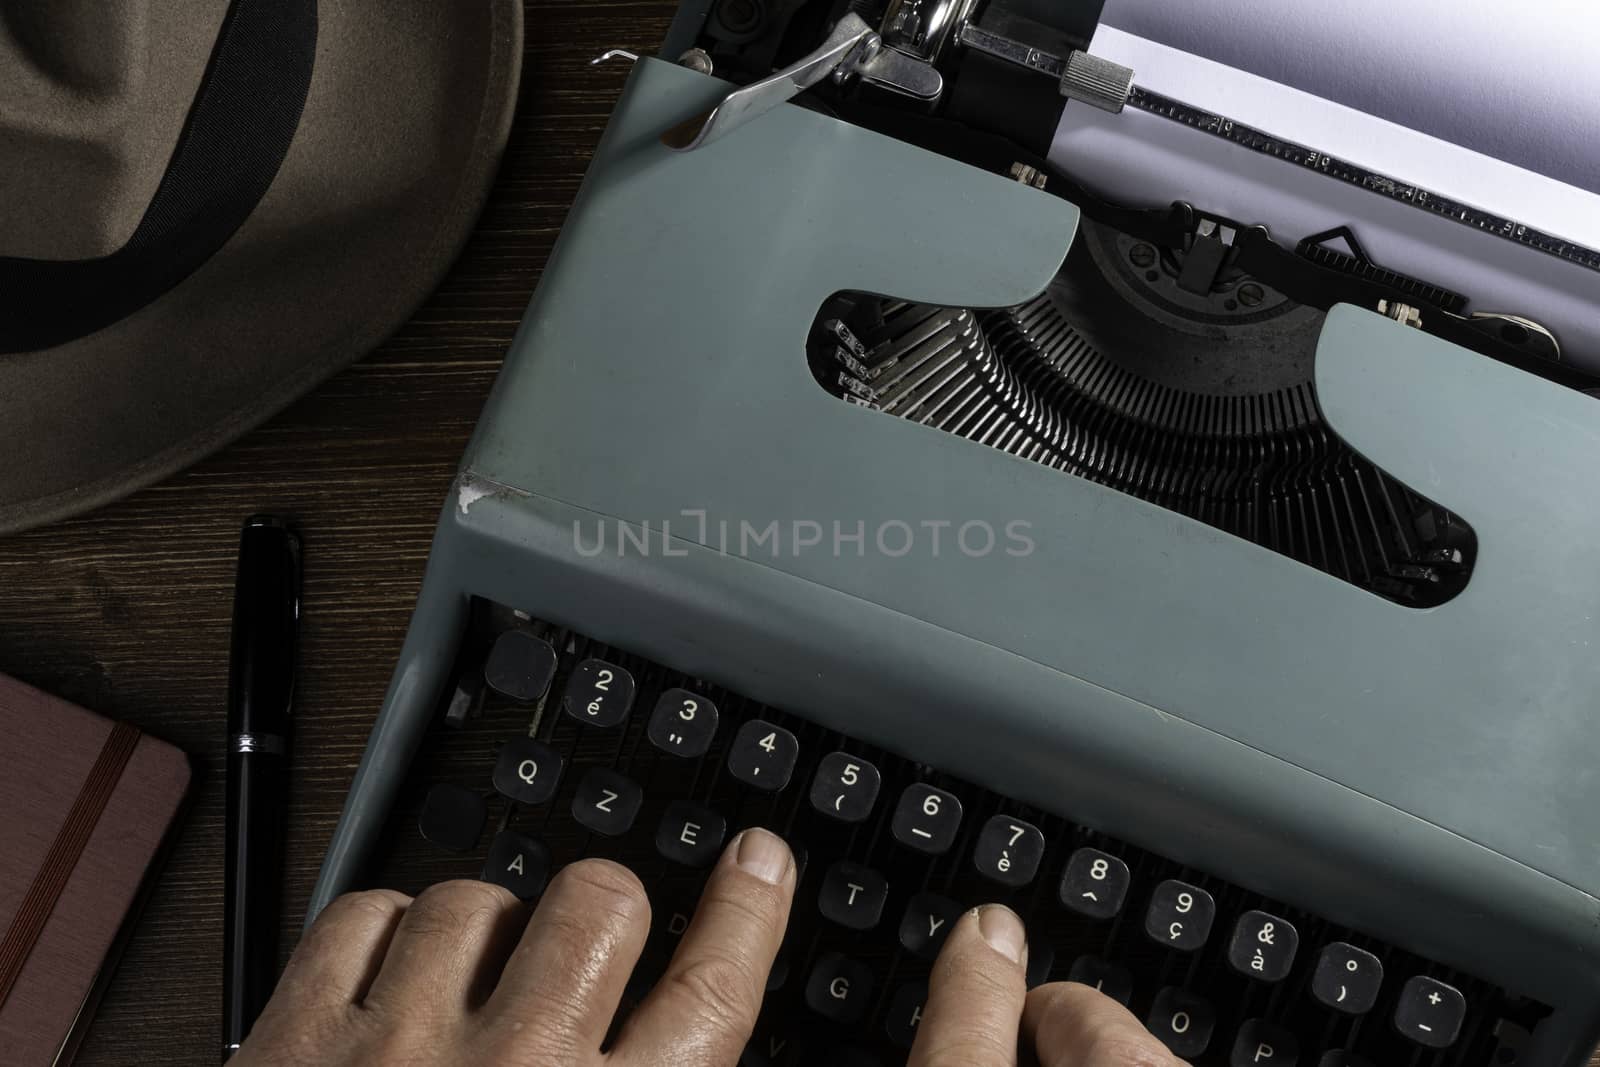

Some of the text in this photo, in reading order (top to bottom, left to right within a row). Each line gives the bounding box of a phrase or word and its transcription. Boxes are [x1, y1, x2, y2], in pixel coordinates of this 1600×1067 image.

[594, 669, 613, 691] 2
[586, 696, 603, 716] é
[679, 699, 698, 721] 3
[758, 732, 776, 753] 4
[518, 759, 538, 785] Q
[840, 763, 860, 786] 5
[595, 789, 618, 813] Z
[923, 795, 942, 816] 6
[680, 822, 701, 845] E
[1008, 825, 1025, 847] 7
[507, 854, 523, 876] A
[997, 850, 1011, 872] è
[1090, 859, 1109, 880] 8
[847, 883, 864, 905] T
[1175, 892, 1193, 913] 9
[929, 915, 945, 937] Y
[1169, 922, 1183, 940] ç
[1257, 922, 1275, 945] &
[1250, 948, 1264, 971] à
[830, 978, 849, 999] G
[1171, 1014, 1190, 1033] O
[1254, 1045, 1273, 1063] P
